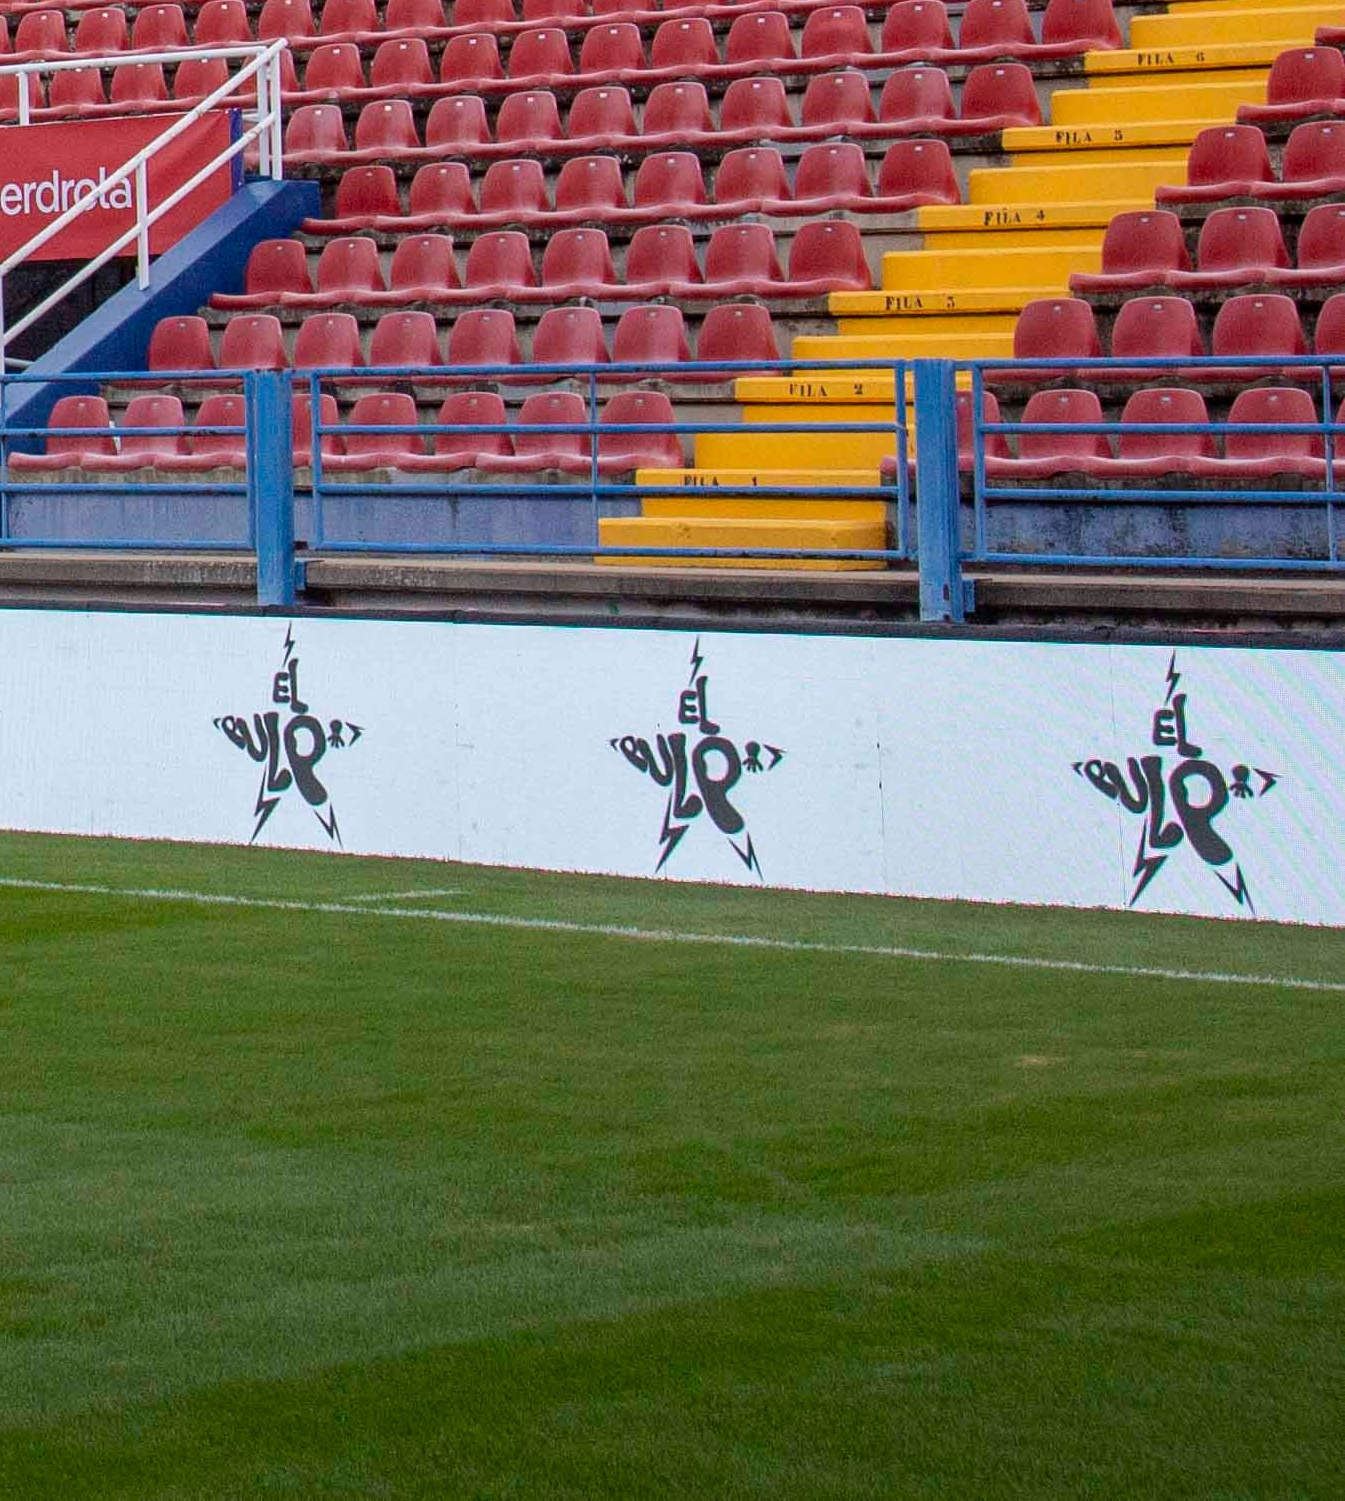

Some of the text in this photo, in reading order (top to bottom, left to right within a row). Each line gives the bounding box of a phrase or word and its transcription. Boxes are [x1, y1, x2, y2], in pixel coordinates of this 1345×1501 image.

[1137, 53, 1175, 66] FILA
[1055, 131, 1093, 145] FILA
[884, 296, 923, 310] FILA
[789, 384, 827, 398] FILA
